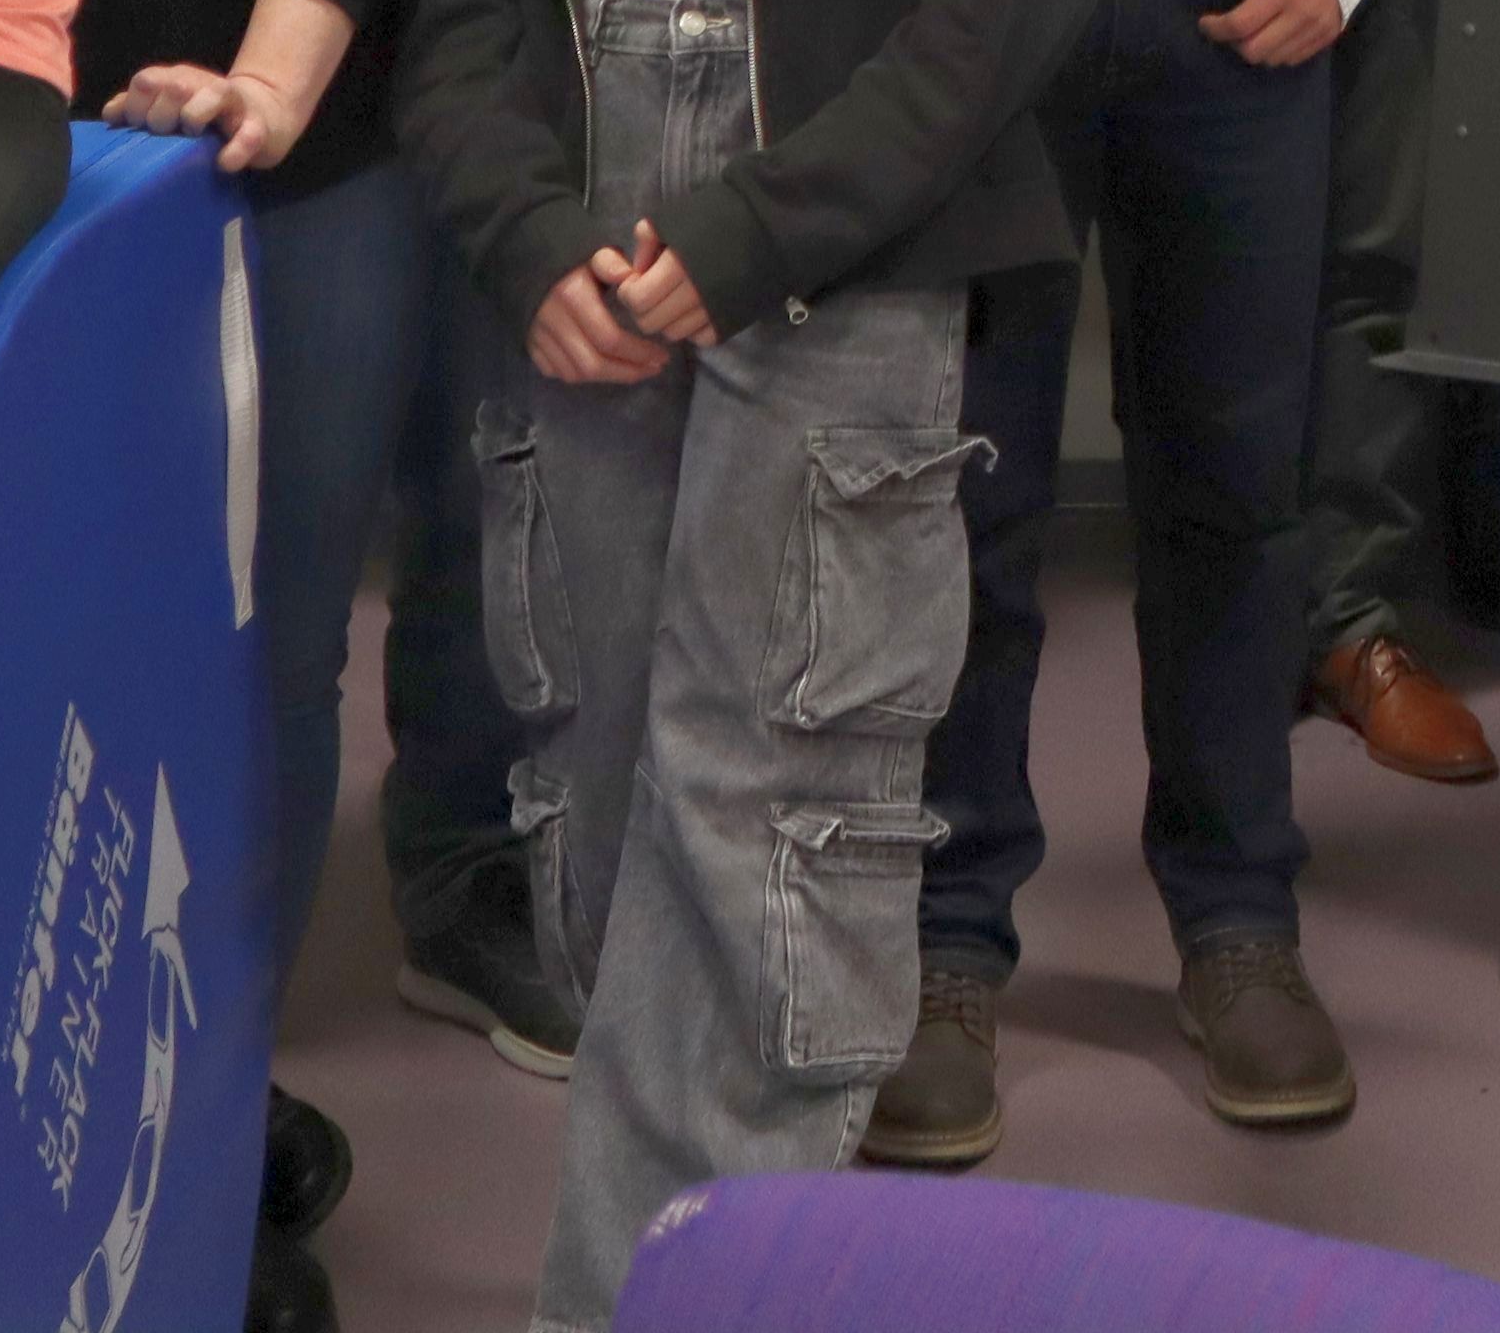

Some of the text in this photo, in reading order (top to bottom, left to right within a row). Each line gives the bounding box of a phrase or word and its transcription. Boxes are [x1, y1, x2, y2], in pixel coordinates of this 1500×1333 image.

[11, 716, 95, 1098] Bänfer
[37, 786, 123, 1172] TRAINER
[52, 810, 135, 1213] FLICK-FLACK
